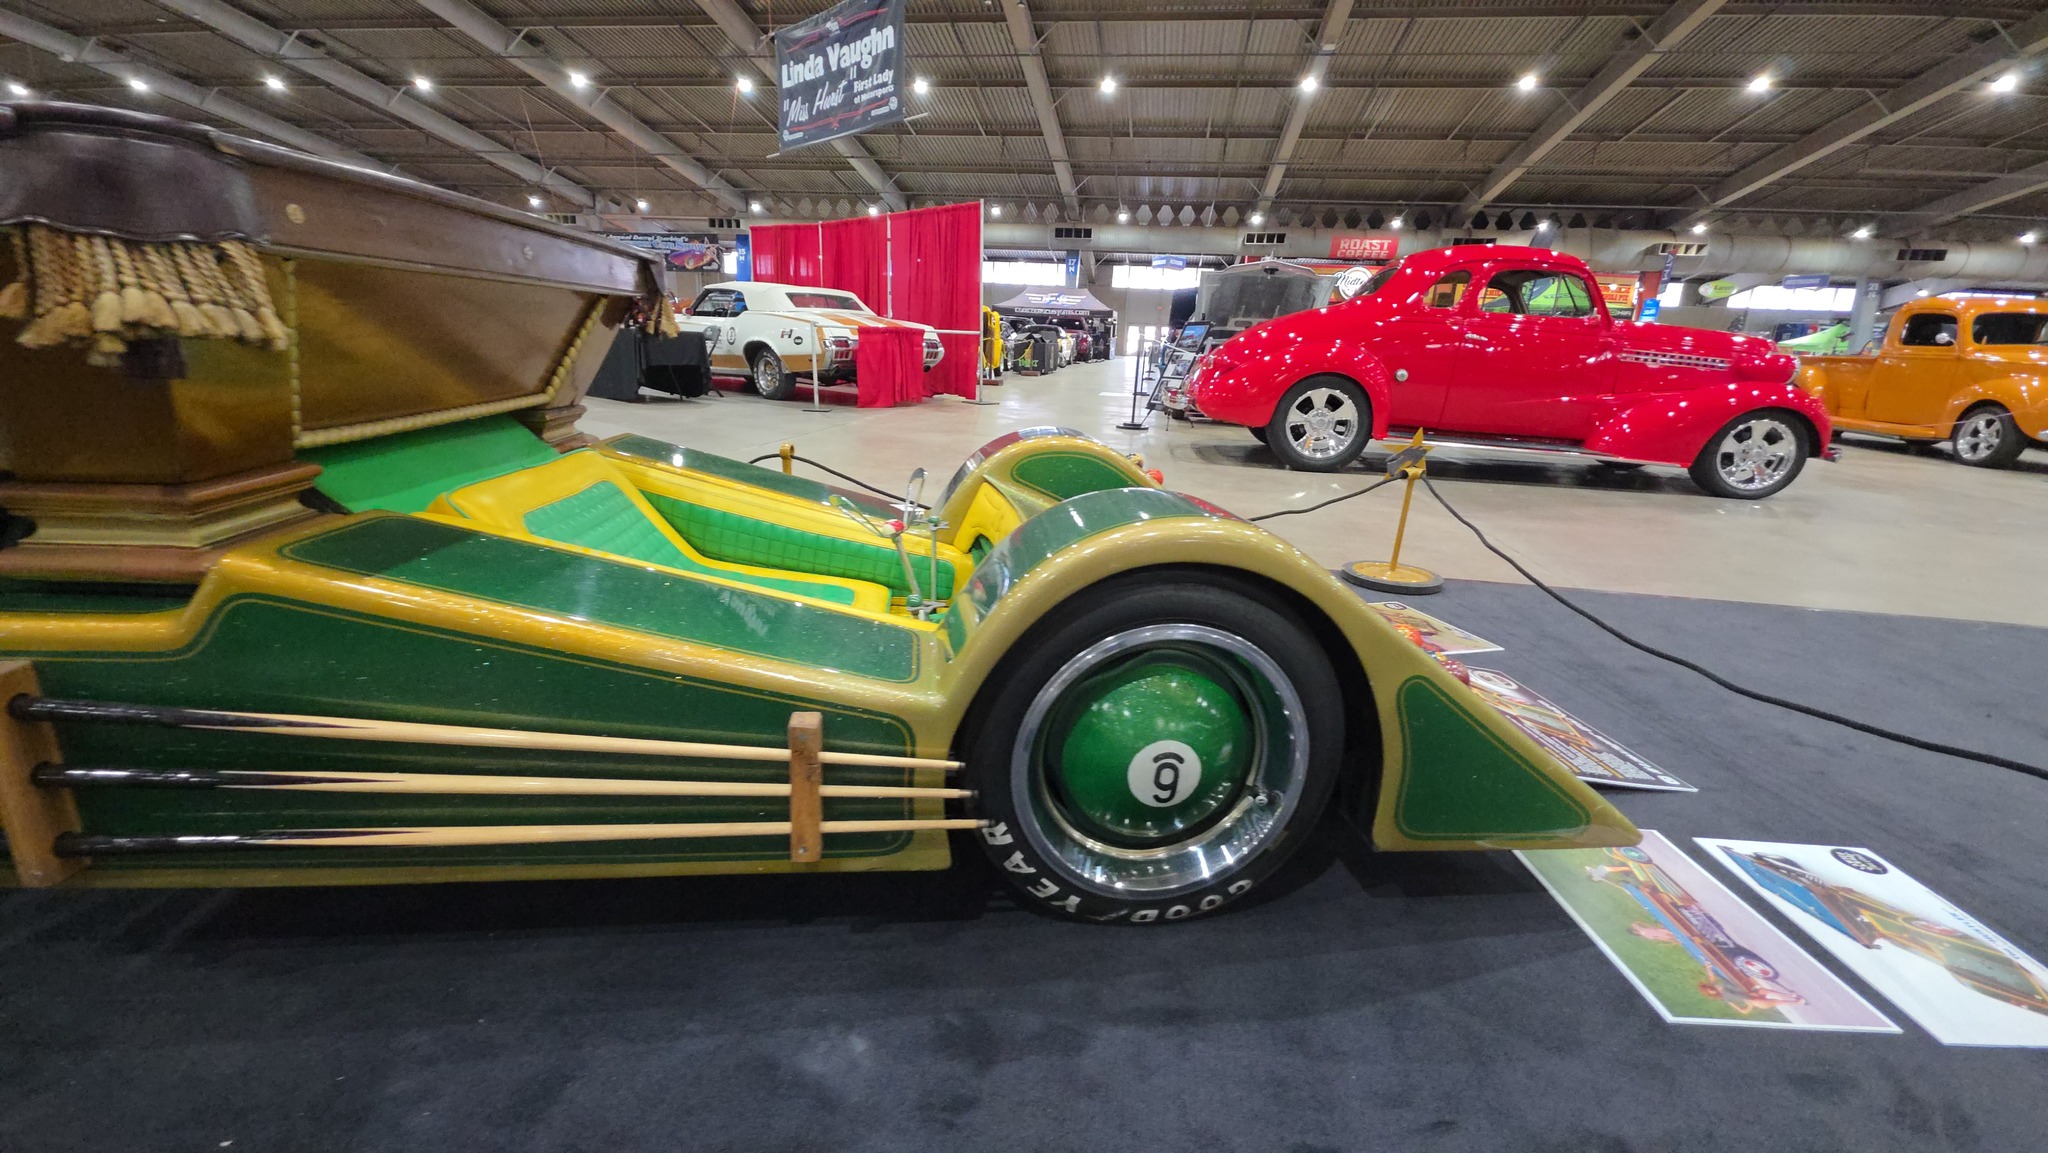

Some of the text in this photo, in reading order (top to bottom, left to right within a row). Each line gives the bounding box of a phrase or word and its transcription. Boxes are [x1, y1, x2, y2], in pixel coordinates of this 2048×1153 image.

[782, 54, 824, 88] Linda
[826, 25, 894, 72] Vaughn
[854, 69, 894, 93] First Lady
[1337, 249, 1389, 258] COFFEE
[1340, 239, 1392, 250] ROAST
[1662, 254, 1674, 281] ATM
